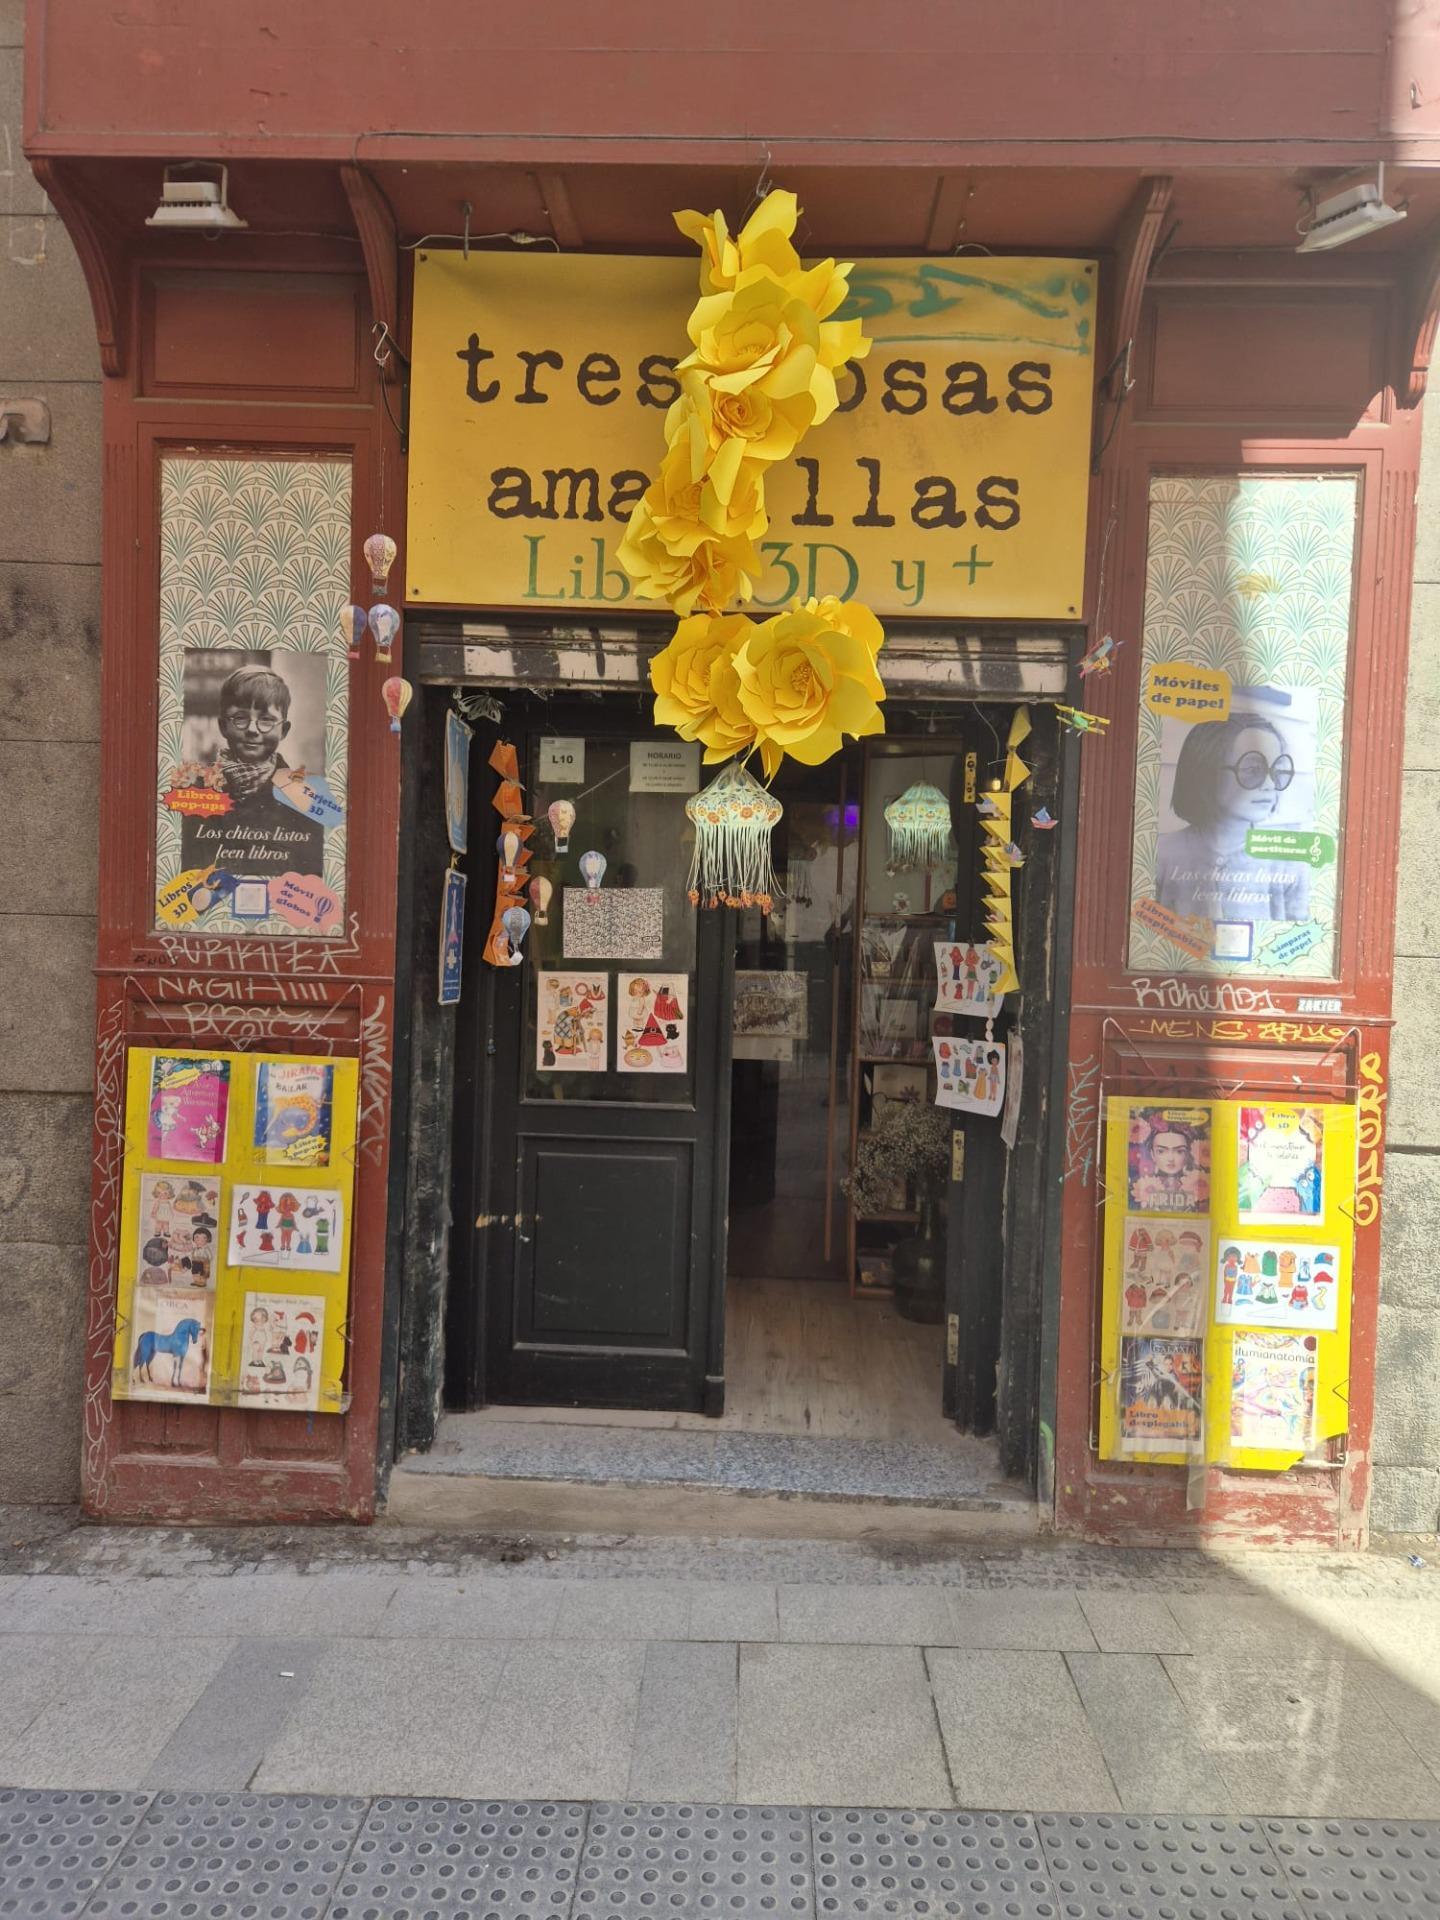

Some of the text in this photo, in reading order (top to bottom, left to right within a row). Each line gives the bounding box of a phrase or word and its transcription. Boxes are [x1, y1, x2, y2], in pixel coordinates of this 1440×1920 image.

[456, 332, 1053, 415] tres osas
[487, 456, 1022, 530] amallas
[752, 542, 859, 607] 3D
[891, 560, 926, 607] y
[1153, 675, 1219, 692] Móviles
[1151, 693, 1224, 709] de papel
[552, 754, 574, 764] L10
[176, 789, 221, 801] Libros
[303, 785, 342, 812] Tarjetas
[171, 801, 225, 811] pop-ups
[310, 805, 324, 816] 3D
[196, 824, 311, 842] Los chicos listos
[215, 844, 290, 861] leen libros
[1170, 865, 1296, 884] Las chicas listas
[158, 881, 193, 908] Libros
[1226, 886, 1272, 903] libros
[173, 902, 188, 918] 3D
[1141, 901, 1174, 924] Libros
